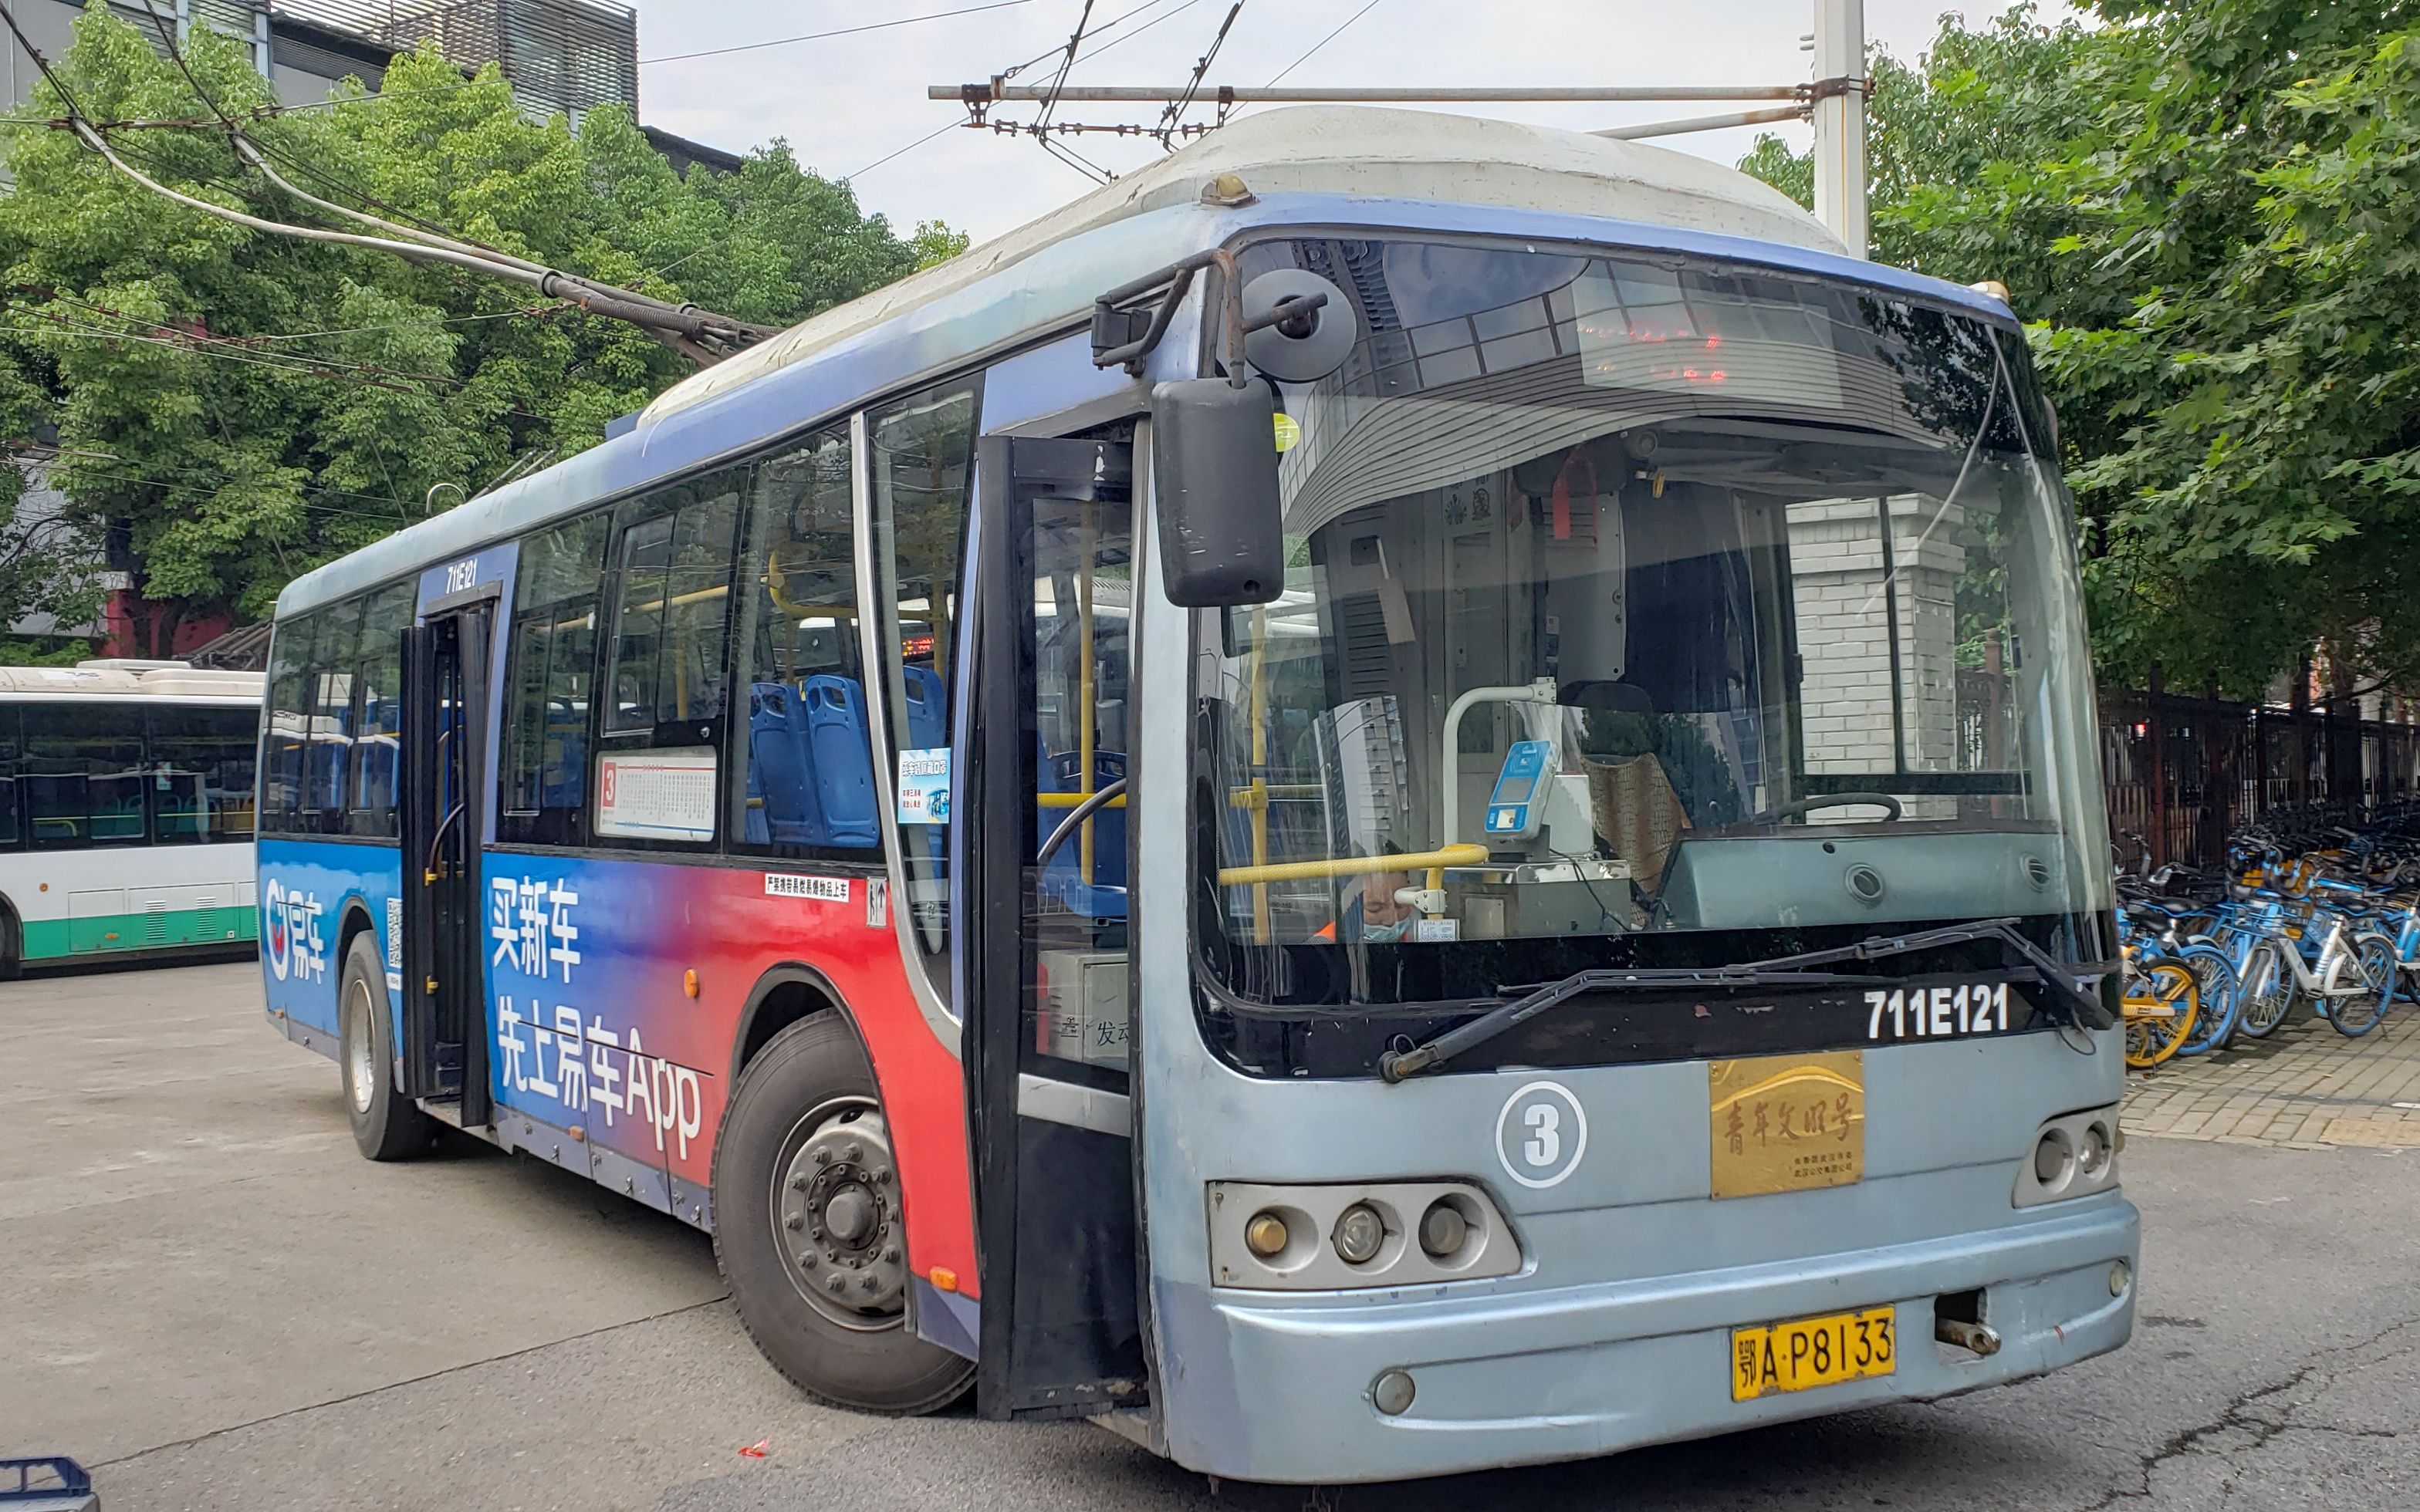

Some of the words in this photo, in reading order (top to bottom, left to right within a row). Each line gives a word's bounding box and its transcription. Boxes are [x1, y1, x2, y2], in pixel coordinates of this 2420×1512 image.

[446, 558, 478, 595] 711E121
[606, 770, 614, 801] 3
[768, 876, 847, 899] 严禁携带易燃易爆物品上车
[288, 890, 325, 984] 易车
[492, 876, 580, 984] 买新车
[1864, 983, 2008, 1038] 711E121
[499, 995, 701, 1160] 先上易车App
[1524, 1103, 1560, 1166] 3
[1724, 1092, 1852, 1156] 青年文明号
